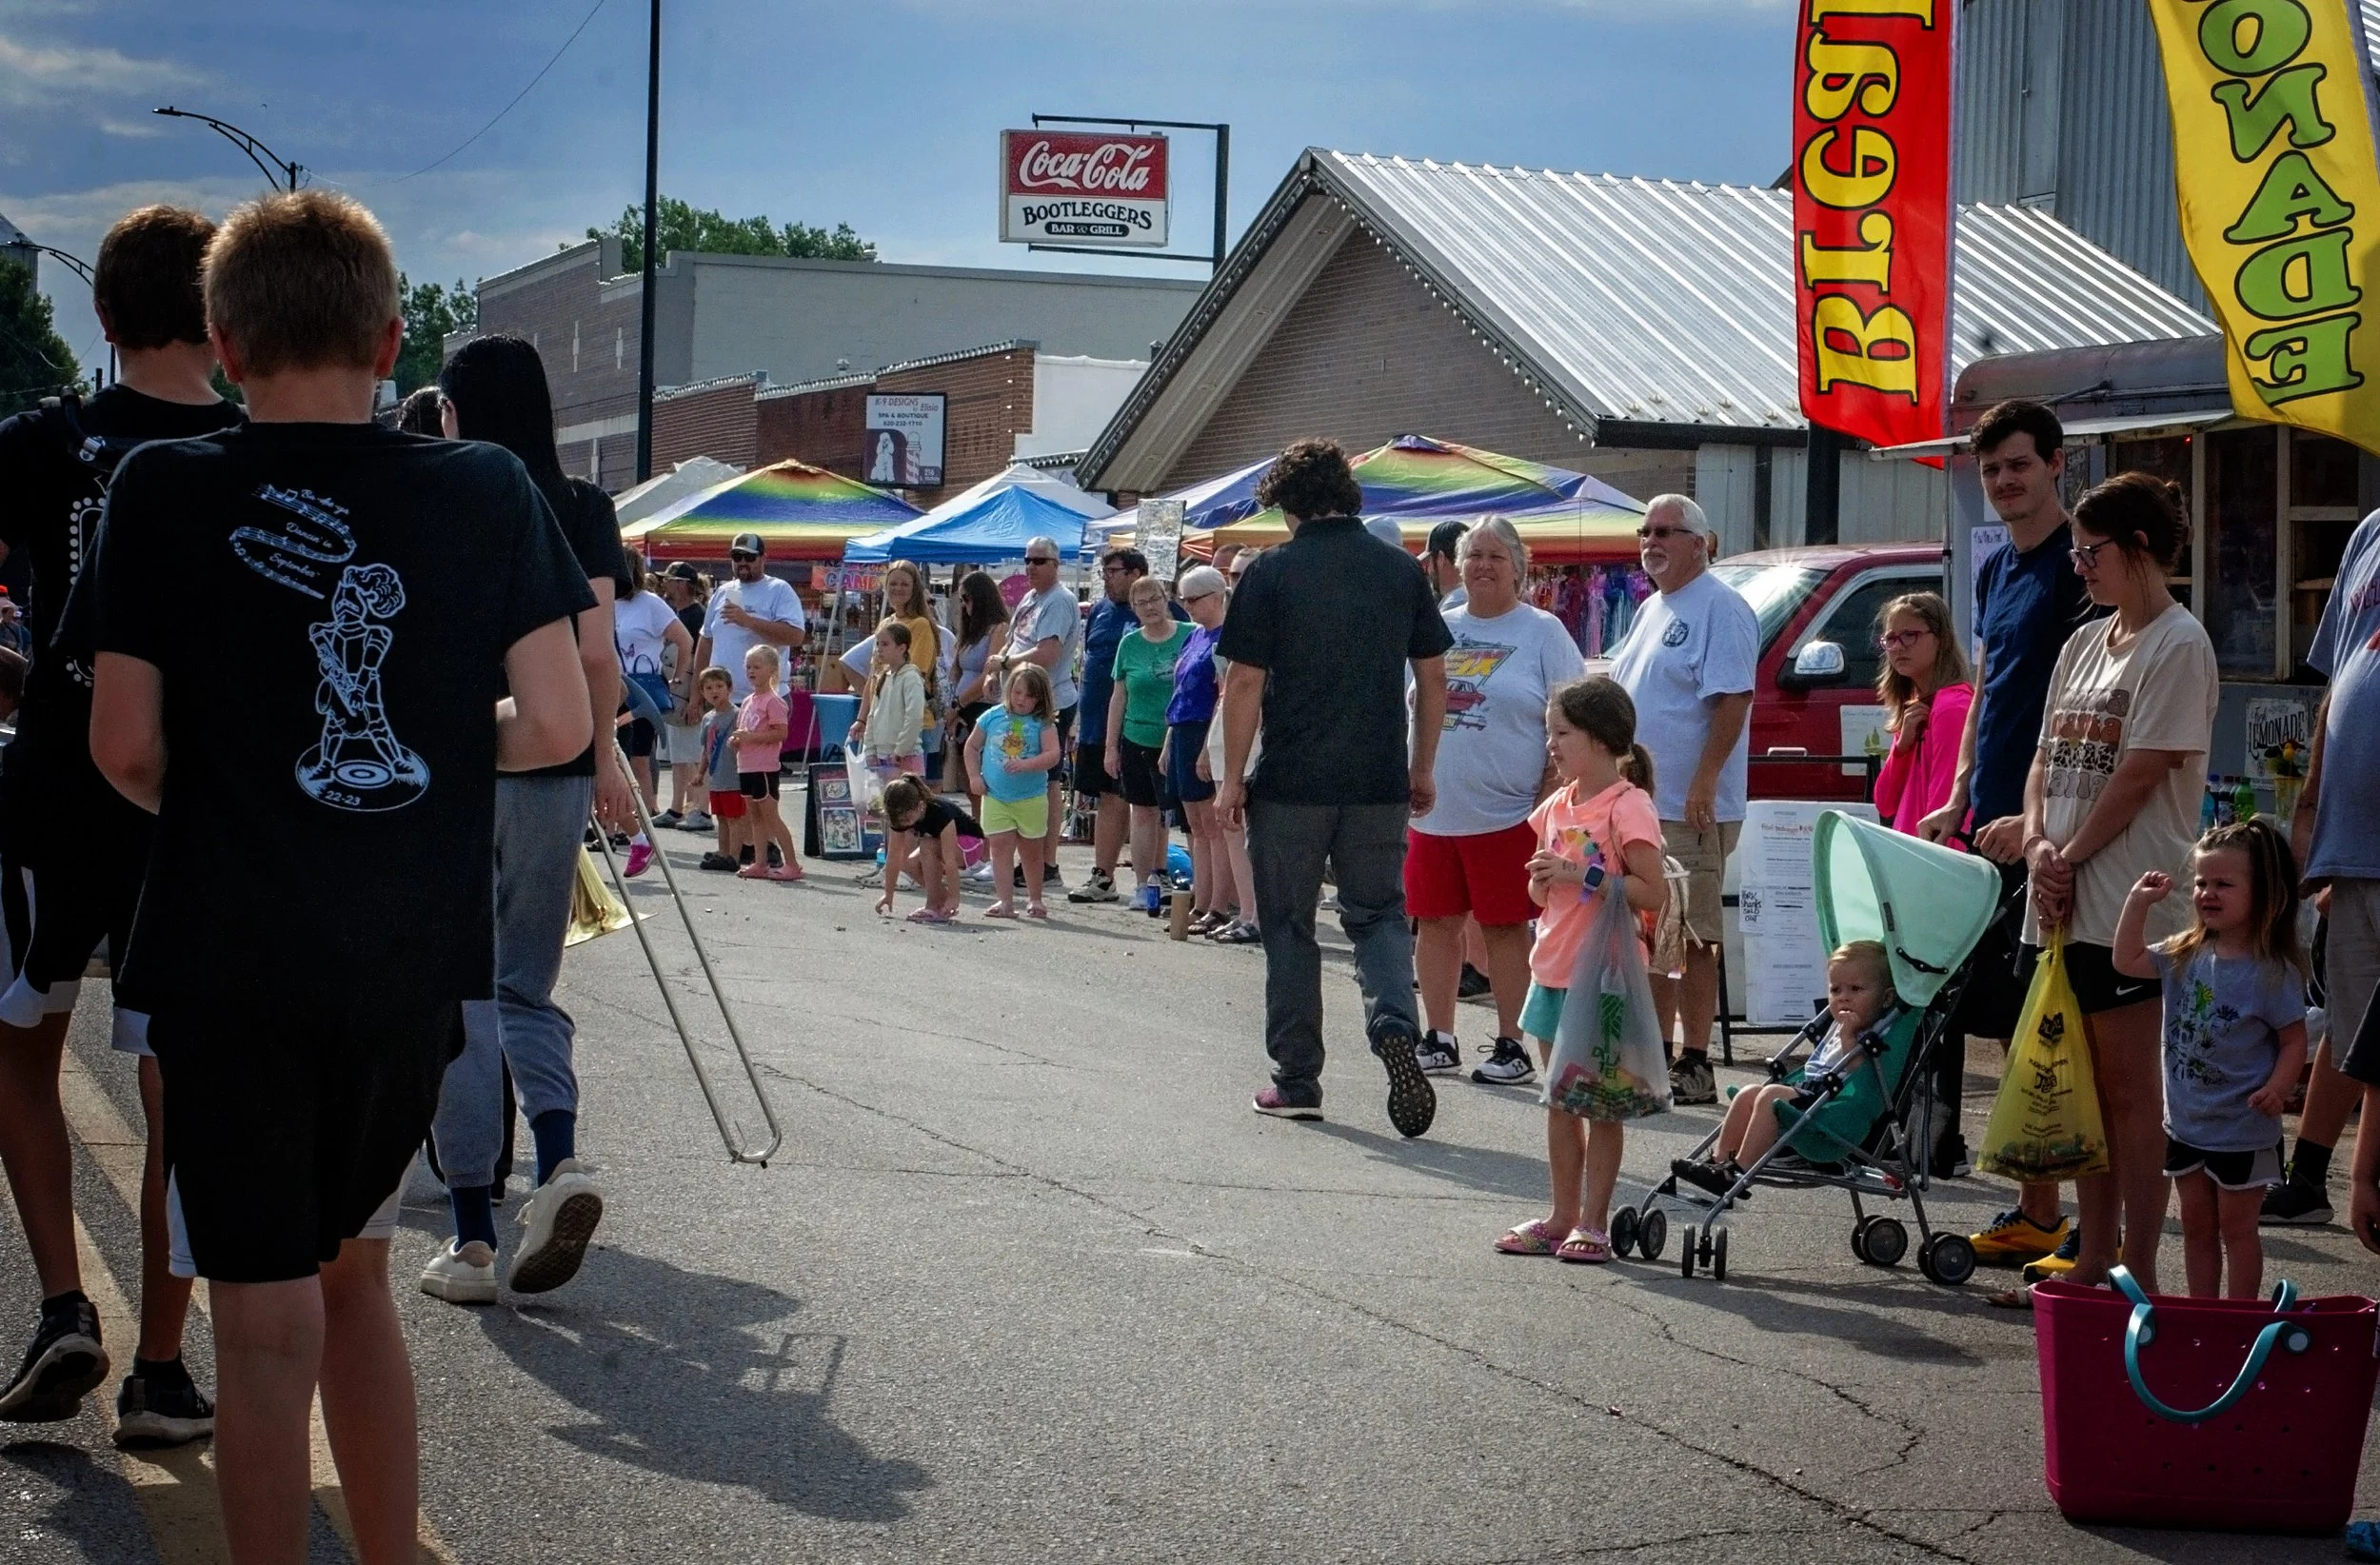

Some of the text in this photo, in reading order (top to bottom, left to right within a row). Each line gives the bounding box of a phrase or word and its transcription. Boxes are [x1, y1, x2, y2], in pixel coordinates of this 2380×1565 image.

[1019, 140, 1155, 191] Coca-Cola
[1022, 201, 1152, 230] BOOTLEGGERS
[1051, 224, 1075, 234] BAR
[1089, 226, 1123, 236] GRILL
[874, 397, 919, 406] K-9 DESIGNS
[2248, 710, 2306, 761] LEMONADE
[325, 790, 361, 807] 22-23
